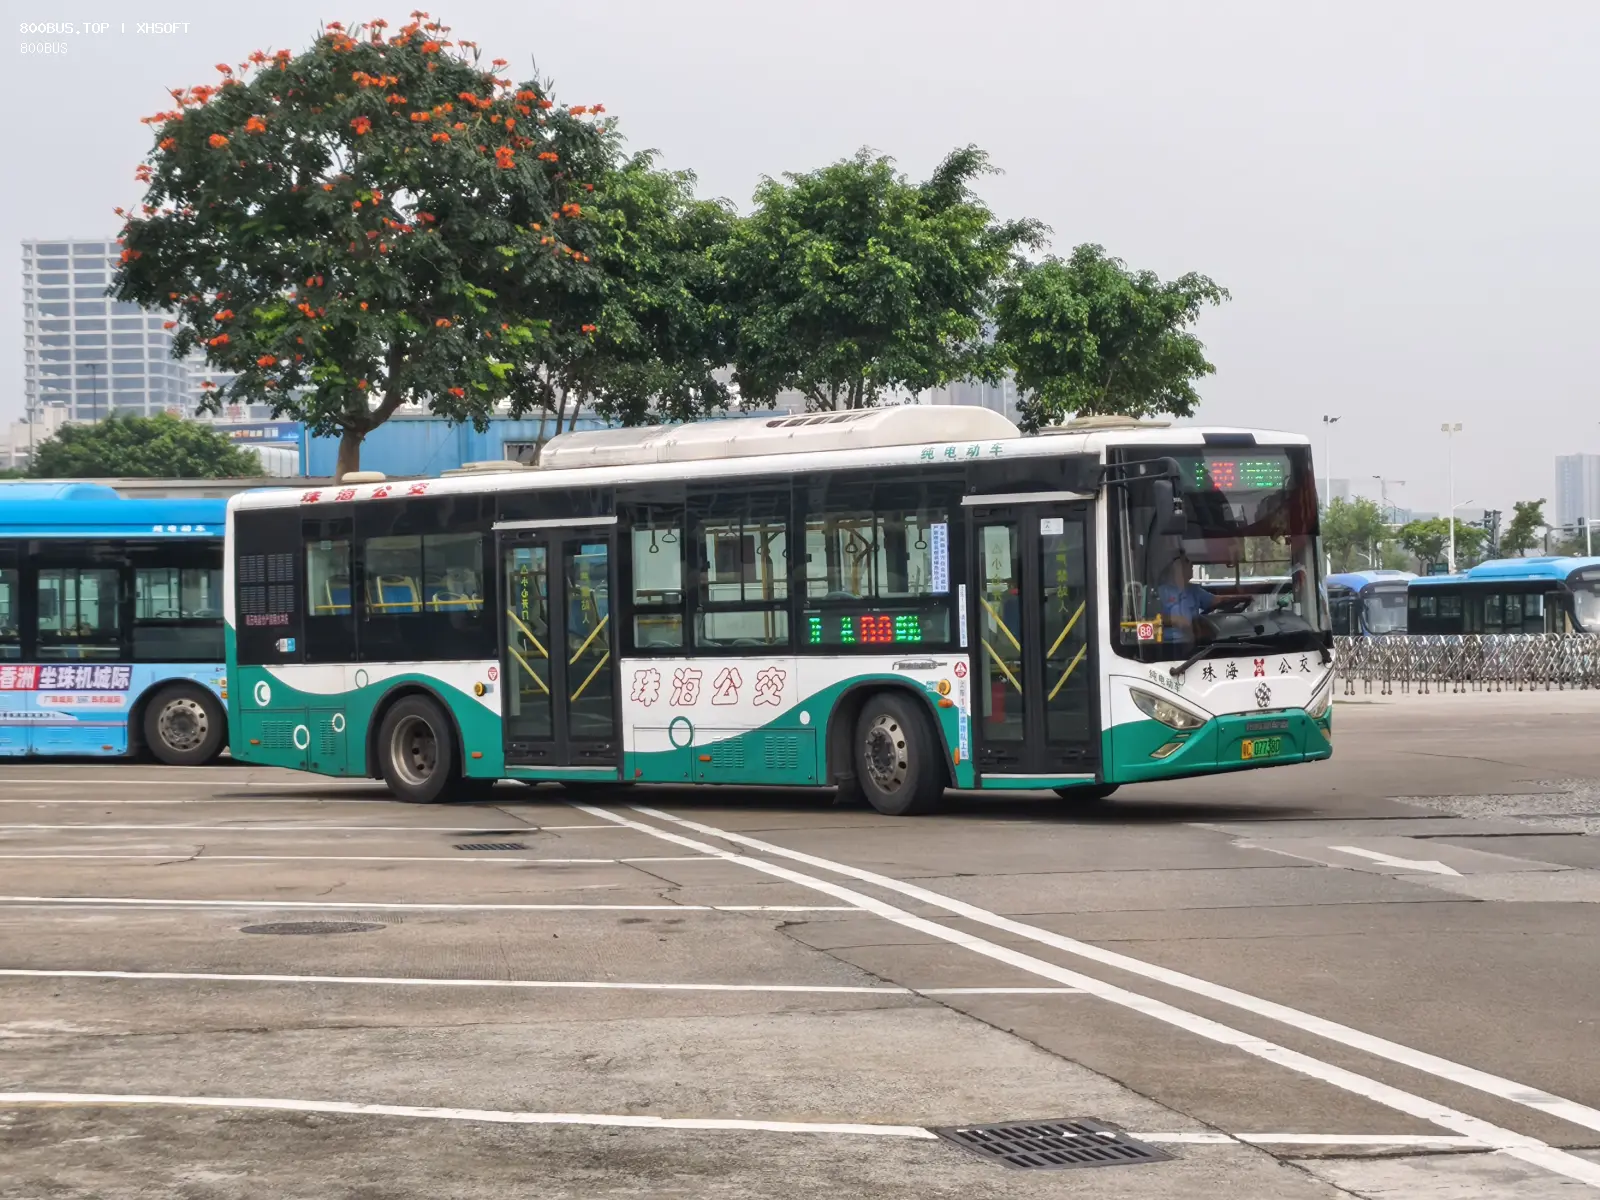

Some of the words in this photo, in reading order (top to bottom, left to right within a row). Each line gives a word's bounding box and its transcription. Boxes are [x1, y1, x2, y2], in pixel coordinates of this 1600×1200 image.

[920, 442, 1004, 460] 纯电动车
[300, 482, 430, 503] 珠海公交
[38, 666, 131, 689] 坐珠机城际
[1201, 660, 1240, 683] 珠海
[1278, 653, 1312, 674] 公交
[630, 666, 787, 708] 珠海公交
